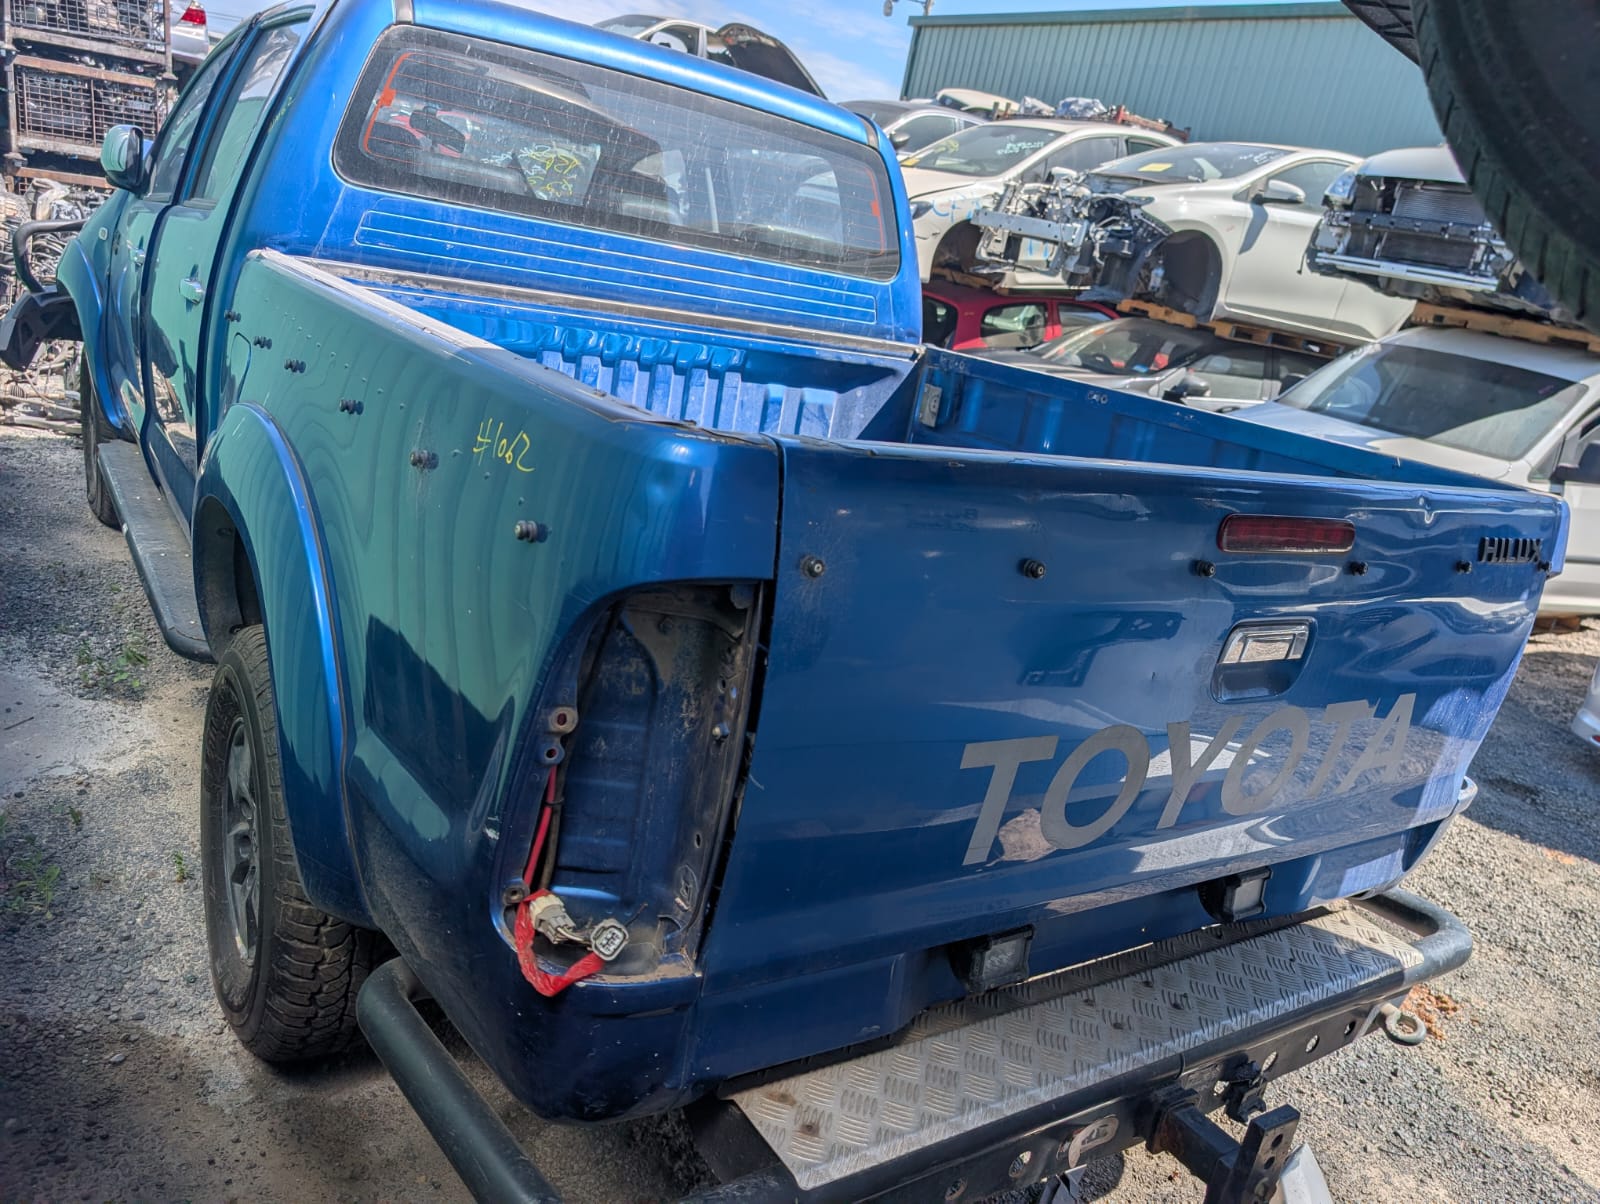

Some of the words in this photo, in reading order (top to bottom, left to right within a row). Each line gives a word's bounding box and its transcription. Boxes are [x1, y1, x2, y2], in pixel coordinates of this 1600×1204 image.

[473, 417, 535, 472] #1062
[1479, 536, 1543, 564] HILUX
[960, 693, 1416, 866] TOYOTA
